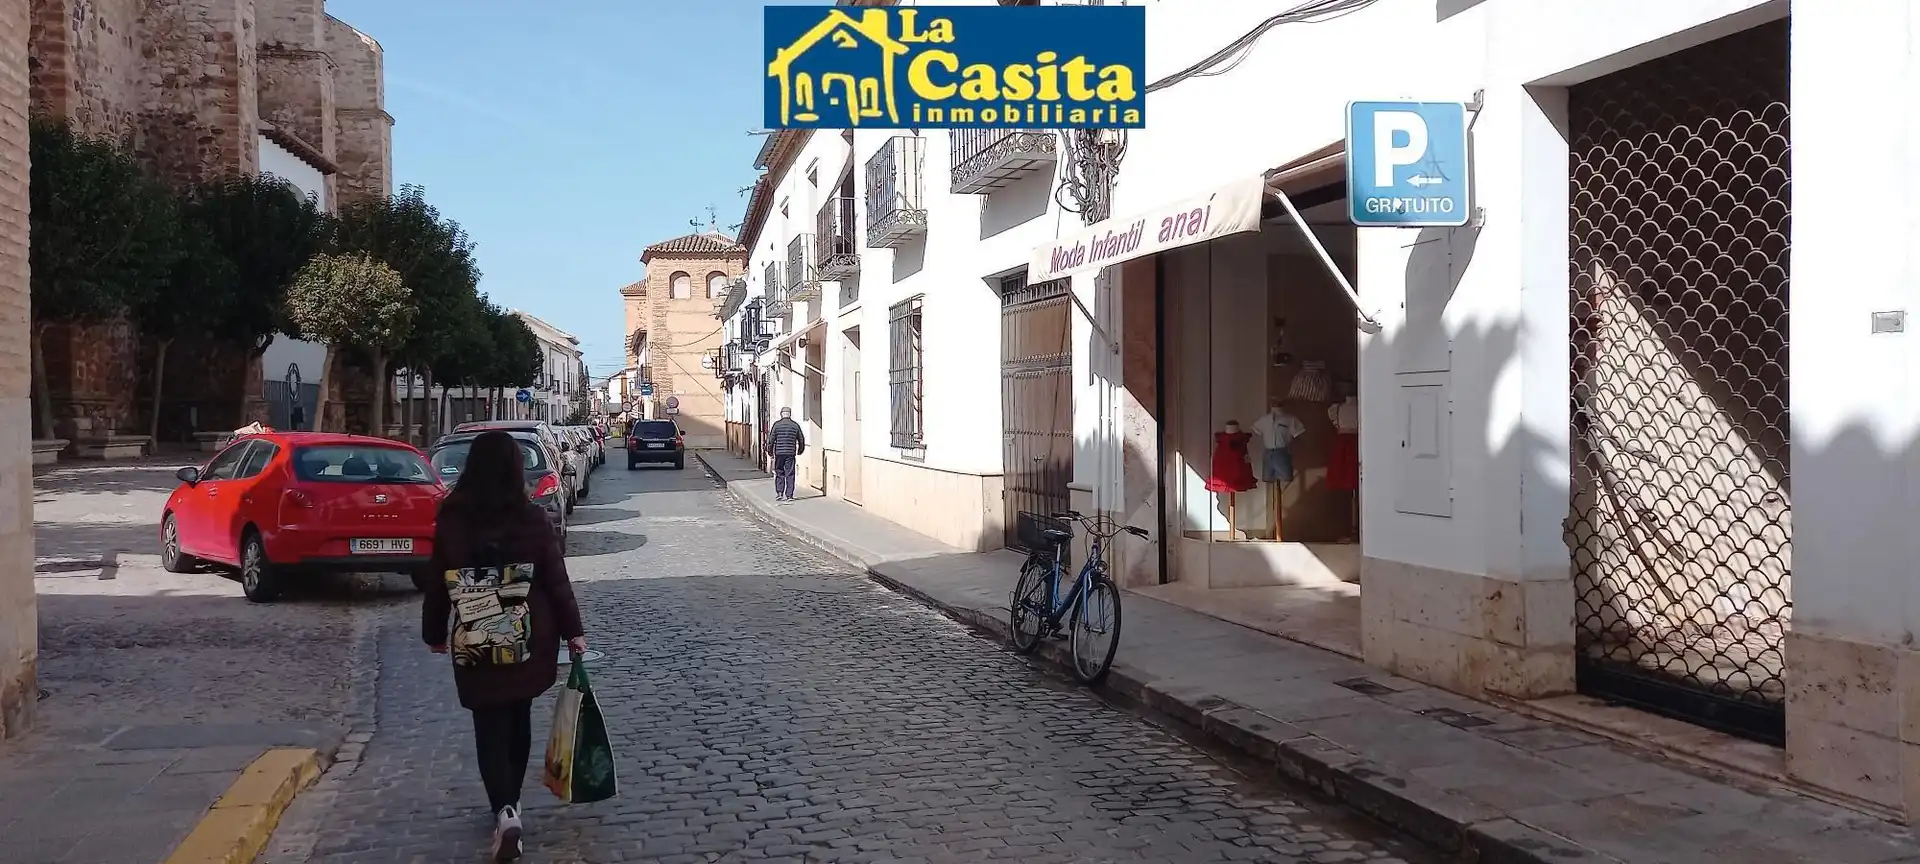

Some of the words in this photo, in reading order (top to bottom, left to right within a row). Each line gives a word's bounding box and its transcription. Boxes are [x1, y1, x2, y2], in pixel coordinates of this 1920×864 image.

[1374, 110, 1428, 187] P
[1365, 197, 1454, 213] GRATUITO
[1050, 240, 1085, 274] Moda
[1088, 218, 1146, 264] Infantil
[1158, 192, 1217, 244] anaí
[359, 539, 384, 549] 6691
[391, 539, 411, 549] HVG
